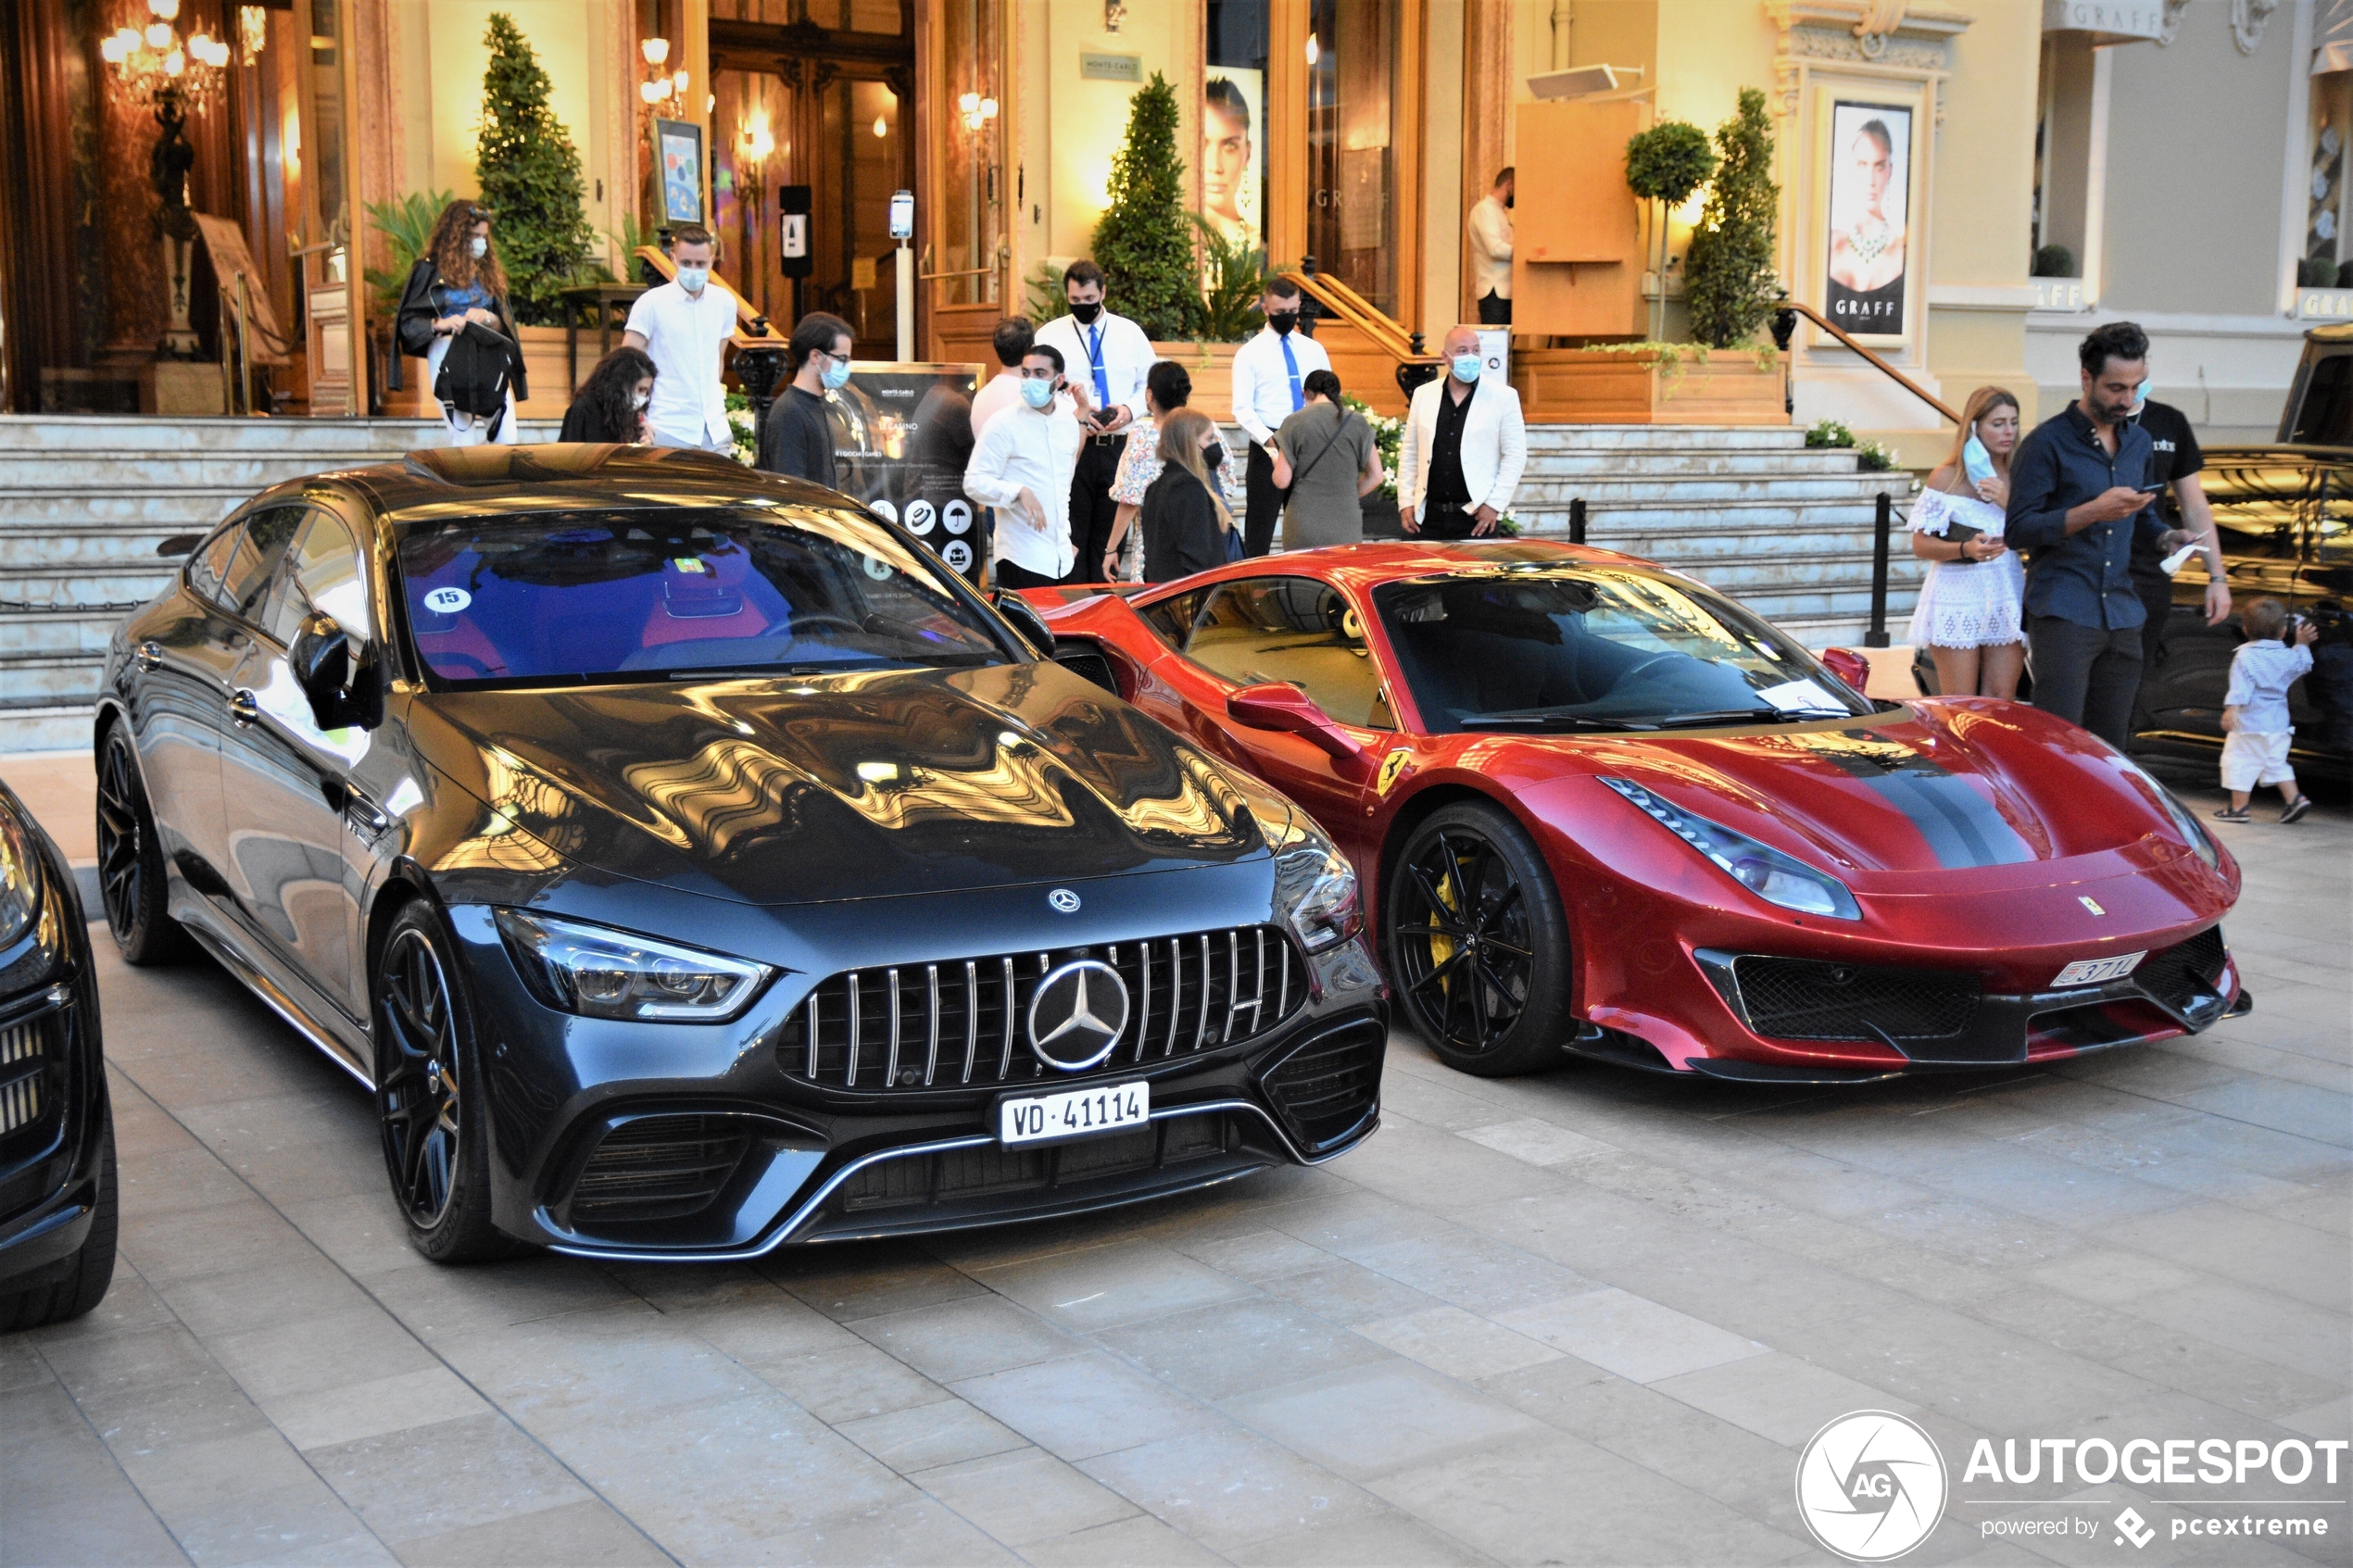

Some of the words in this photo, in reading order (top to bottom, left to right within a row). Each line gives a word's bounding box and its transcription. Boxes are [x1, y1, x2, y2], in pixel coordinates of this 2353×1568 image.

[2074, 4, 2158, 31] GRAFF
[1835, 299, 1894, 317] GRAFF
[2303, 294, 2353, 316] GRA
[887, 422, 918, 431] CASINO
[434, 590, 460, 605] 15
